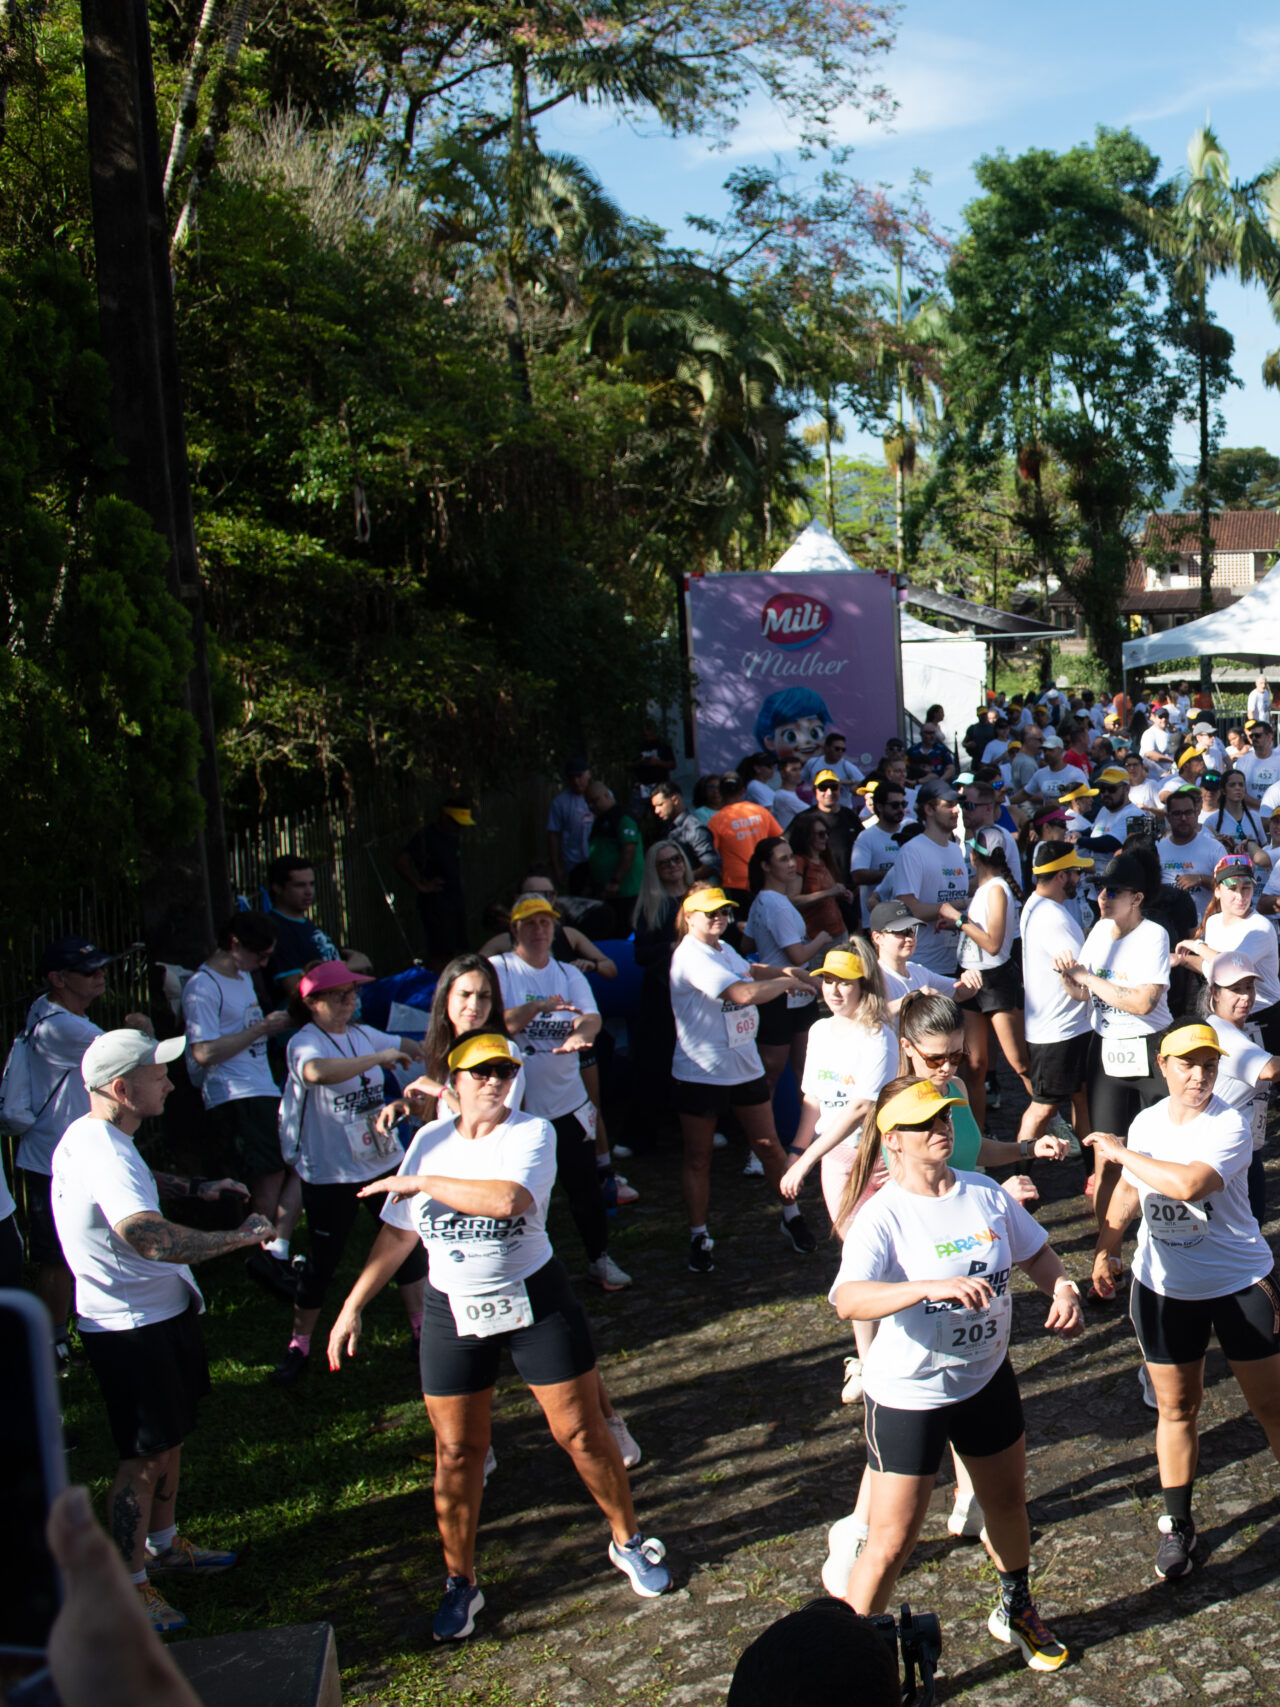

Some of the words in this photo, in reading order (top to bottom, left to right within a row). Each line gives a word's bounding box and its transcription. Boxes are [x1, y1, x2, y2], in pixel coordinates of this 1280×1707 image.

[761, 602, 823, 637] Mili
[741, 650, 848, 678] Mulher
[731, 814, 762, 831] STAFF
[736, 1018, 756, 1034] 603
[1107, 1051, 1136, 1064] 002
[1149, 1203, 1191, 1222] 202
[419, 1217, 527, 1233] CORRIDA
[444, 1228, 525, 1241] SERRA
[466, 1298, 513, 1320] 093
[951, 1319, 998, 1347] 203
